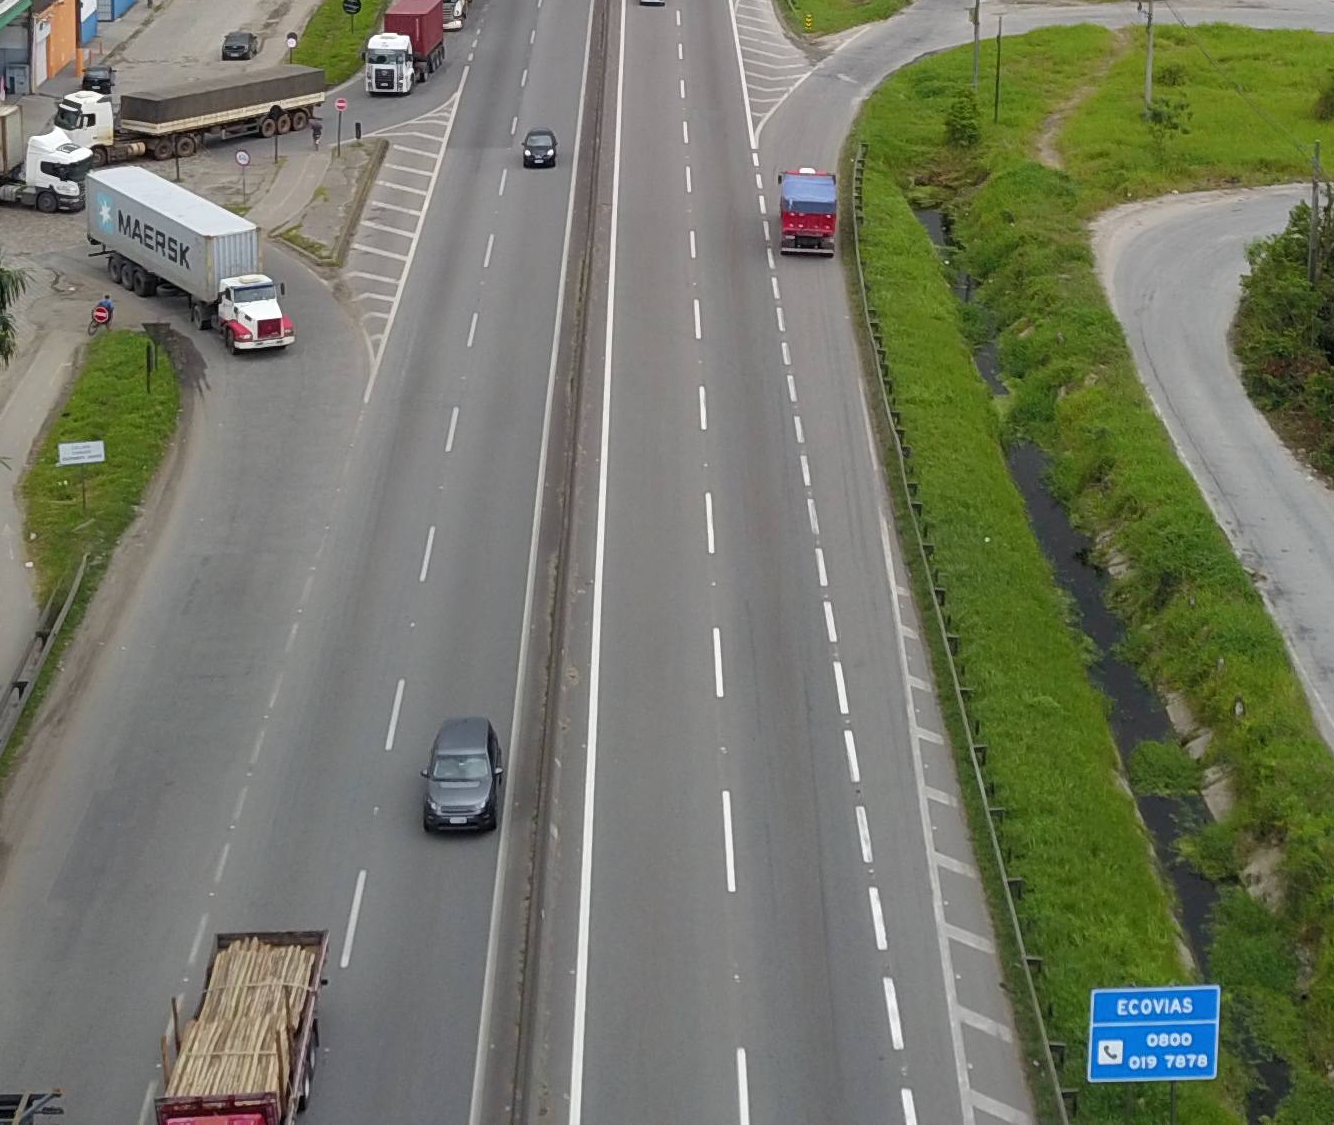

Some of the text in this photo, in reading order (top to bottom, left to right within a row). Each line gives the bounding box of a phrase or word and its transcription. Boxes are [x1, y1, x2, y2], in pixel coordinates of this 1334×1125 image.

[117, 209, 191, 270] MAERSK
[1117, 997, 1193, 1016] ECOVIAS
[1146, 1032, 1193, 1047] 0800
[1128, 1054, 1208, 1070] 019 7878
